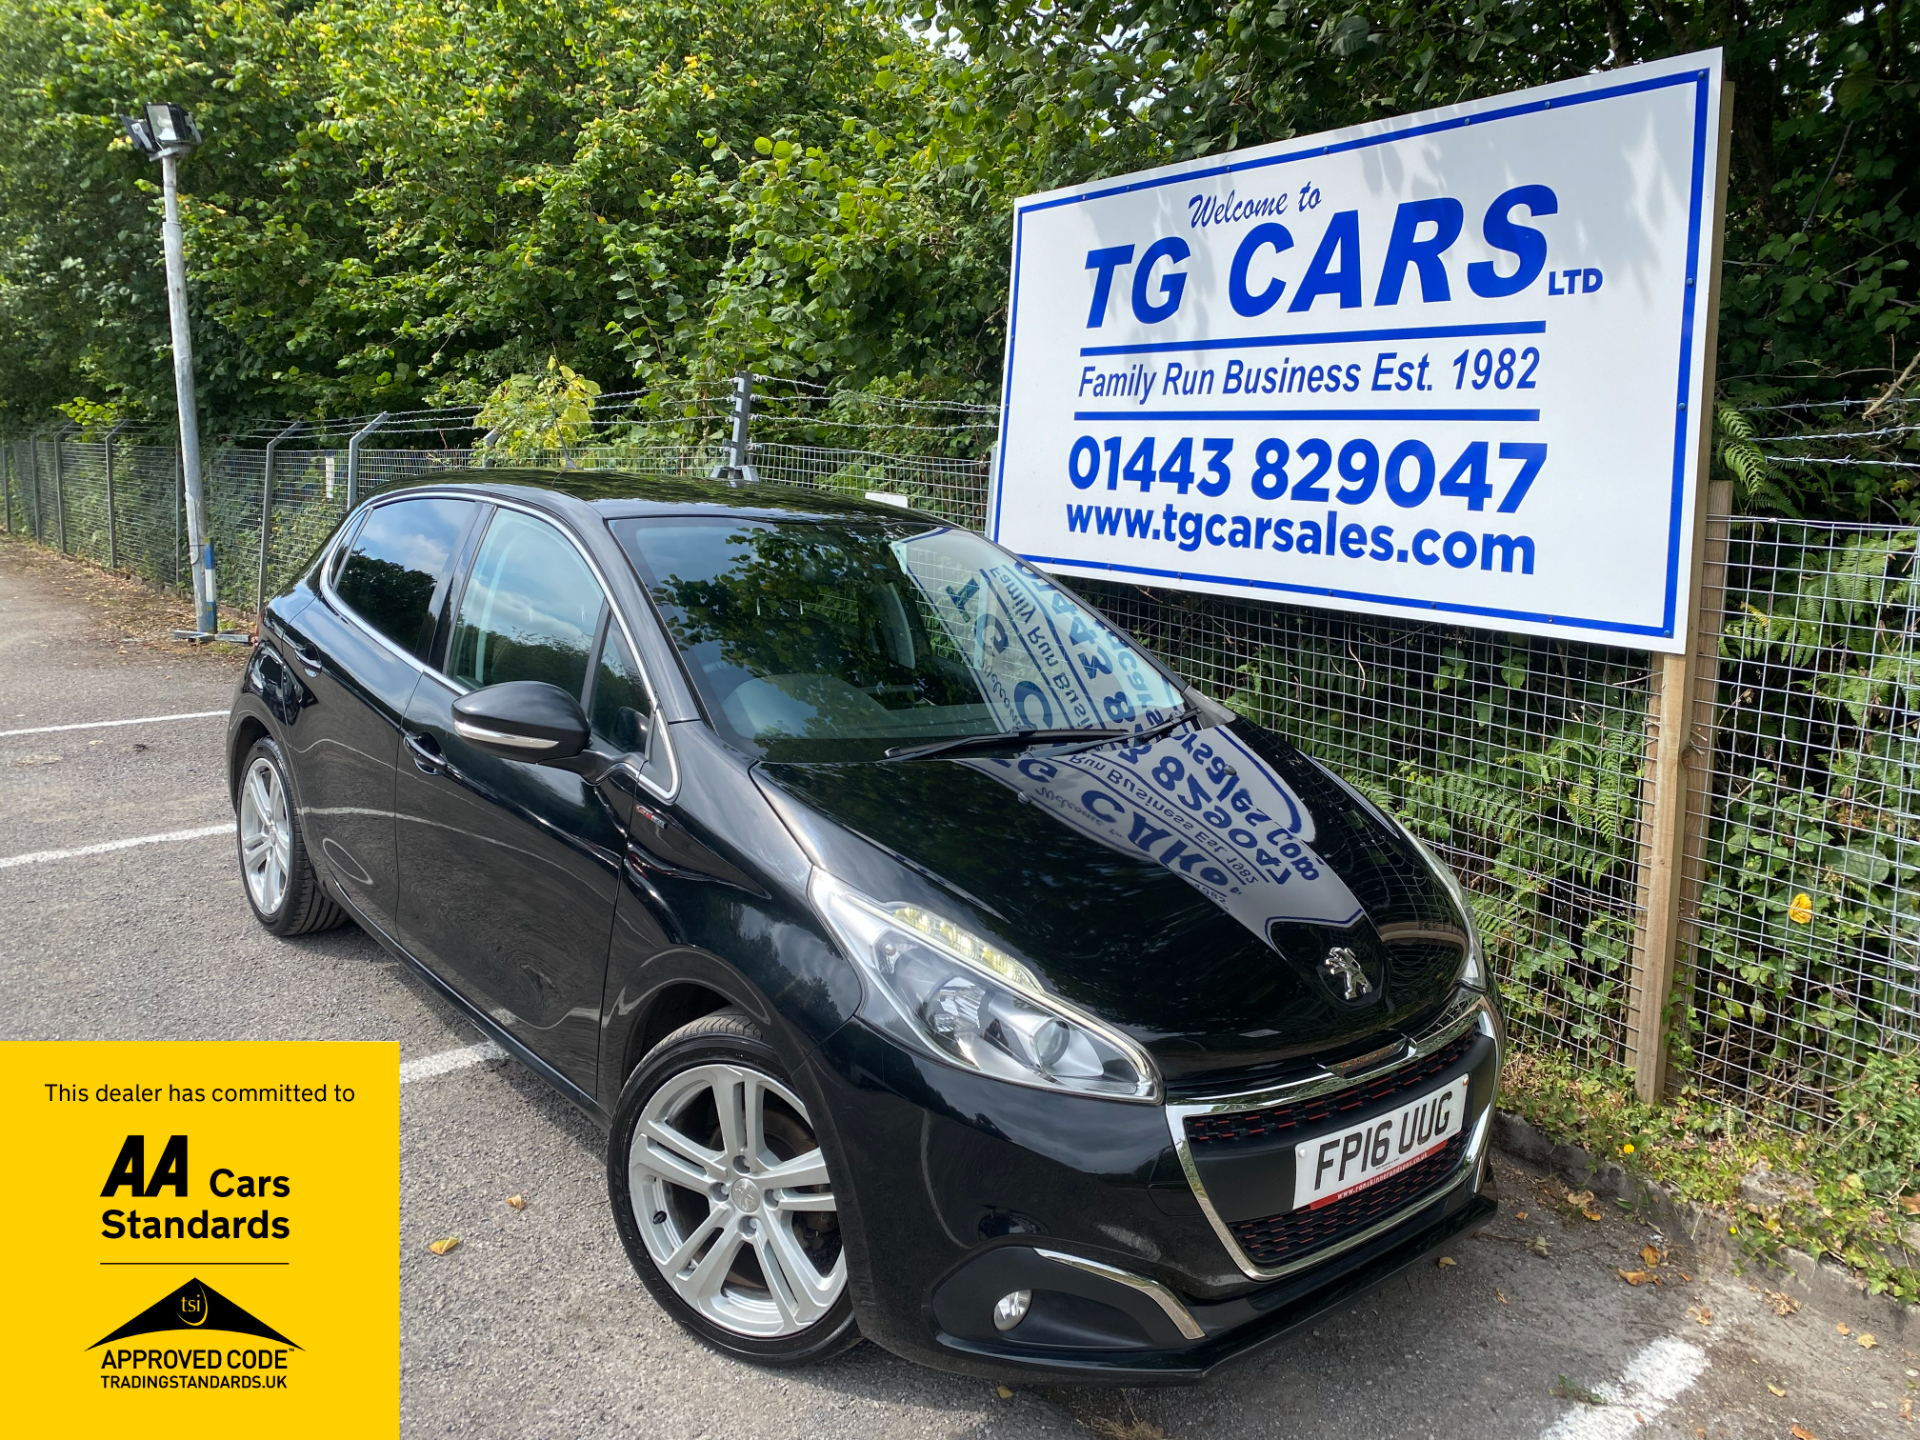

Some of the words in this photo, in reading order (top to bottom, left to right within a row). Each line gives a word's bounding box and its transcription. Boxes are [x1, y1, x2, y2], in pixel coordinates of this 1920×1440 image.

[1188, 189, 1288, 229] Welcome
[1298, 181, 1321, 212] to
[1084, 236, 1192, 329] TG
[1228, 183, 1559, 318] CARS
[1547, 267, 1604, 297] LTD
[1078, 363, 1157, 406] Family
[1162, 361, 1215, 396] Run
[1222, 358, 1362, 395] Business
[1370, 351, 1433, 392] Est.
[1453, 346, 1540, 391] 1982
[1068, 434, 1235, 498] 01443
[1250, 437, 1548, 514] 829047
[1066, 502, 1536, 576] www.tgcarsales.com
[1313, 1119, 1393, 1191] FP16
[1398, 1090, 1453, 1155] UUG
